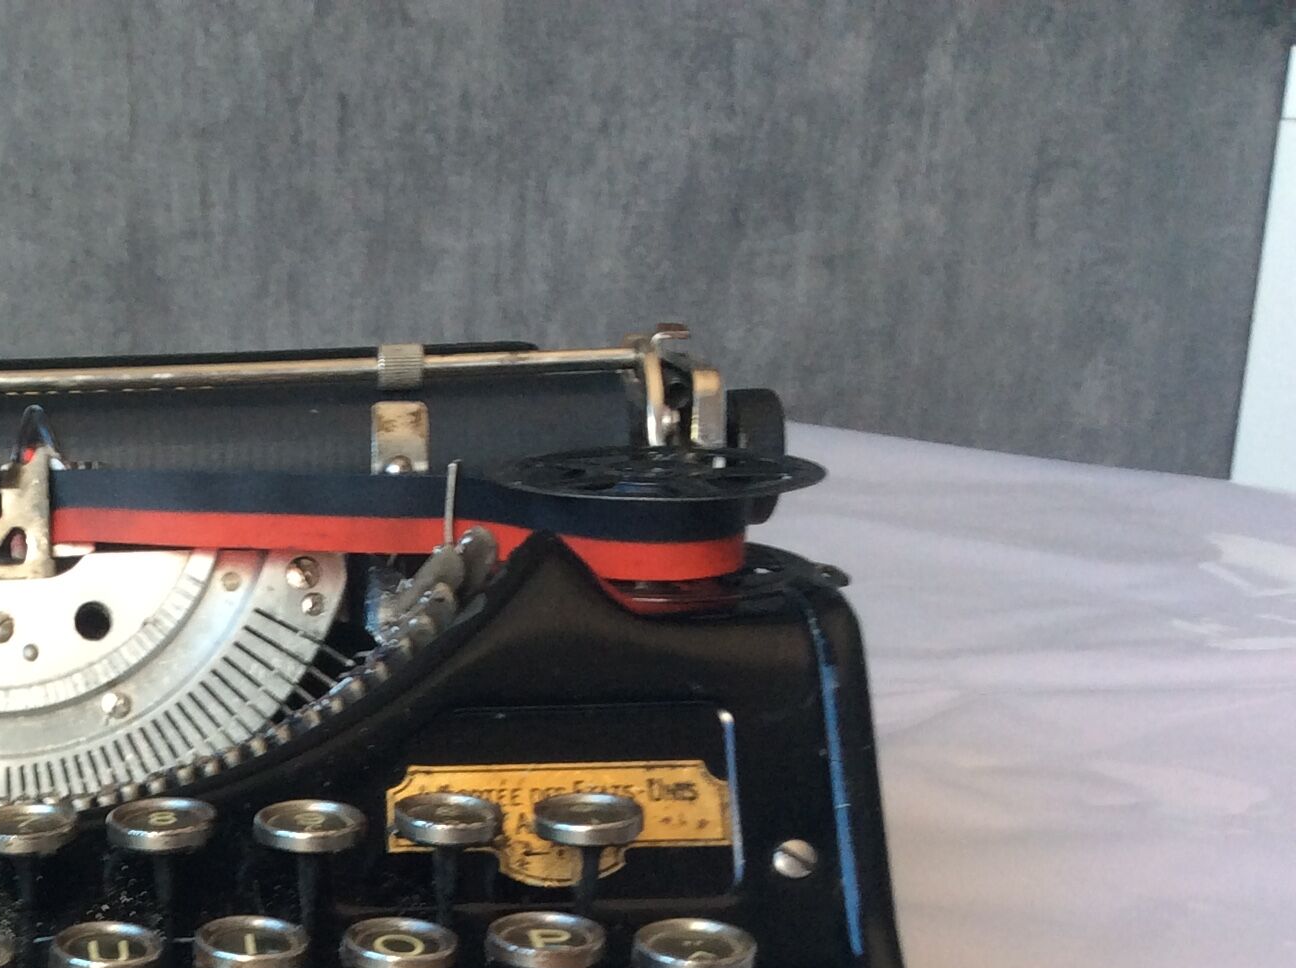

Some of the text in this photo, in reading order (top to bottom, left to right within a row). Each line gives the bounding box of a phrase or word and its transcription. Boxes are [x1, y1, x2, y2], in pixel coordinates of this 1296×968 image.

[149, 811, 178, 827] 8
[86, 939, 131, 962] U
[244, 933, 257, 956] I
[372, 934, 425, 957] O
[528, 928, 572, 951] P
